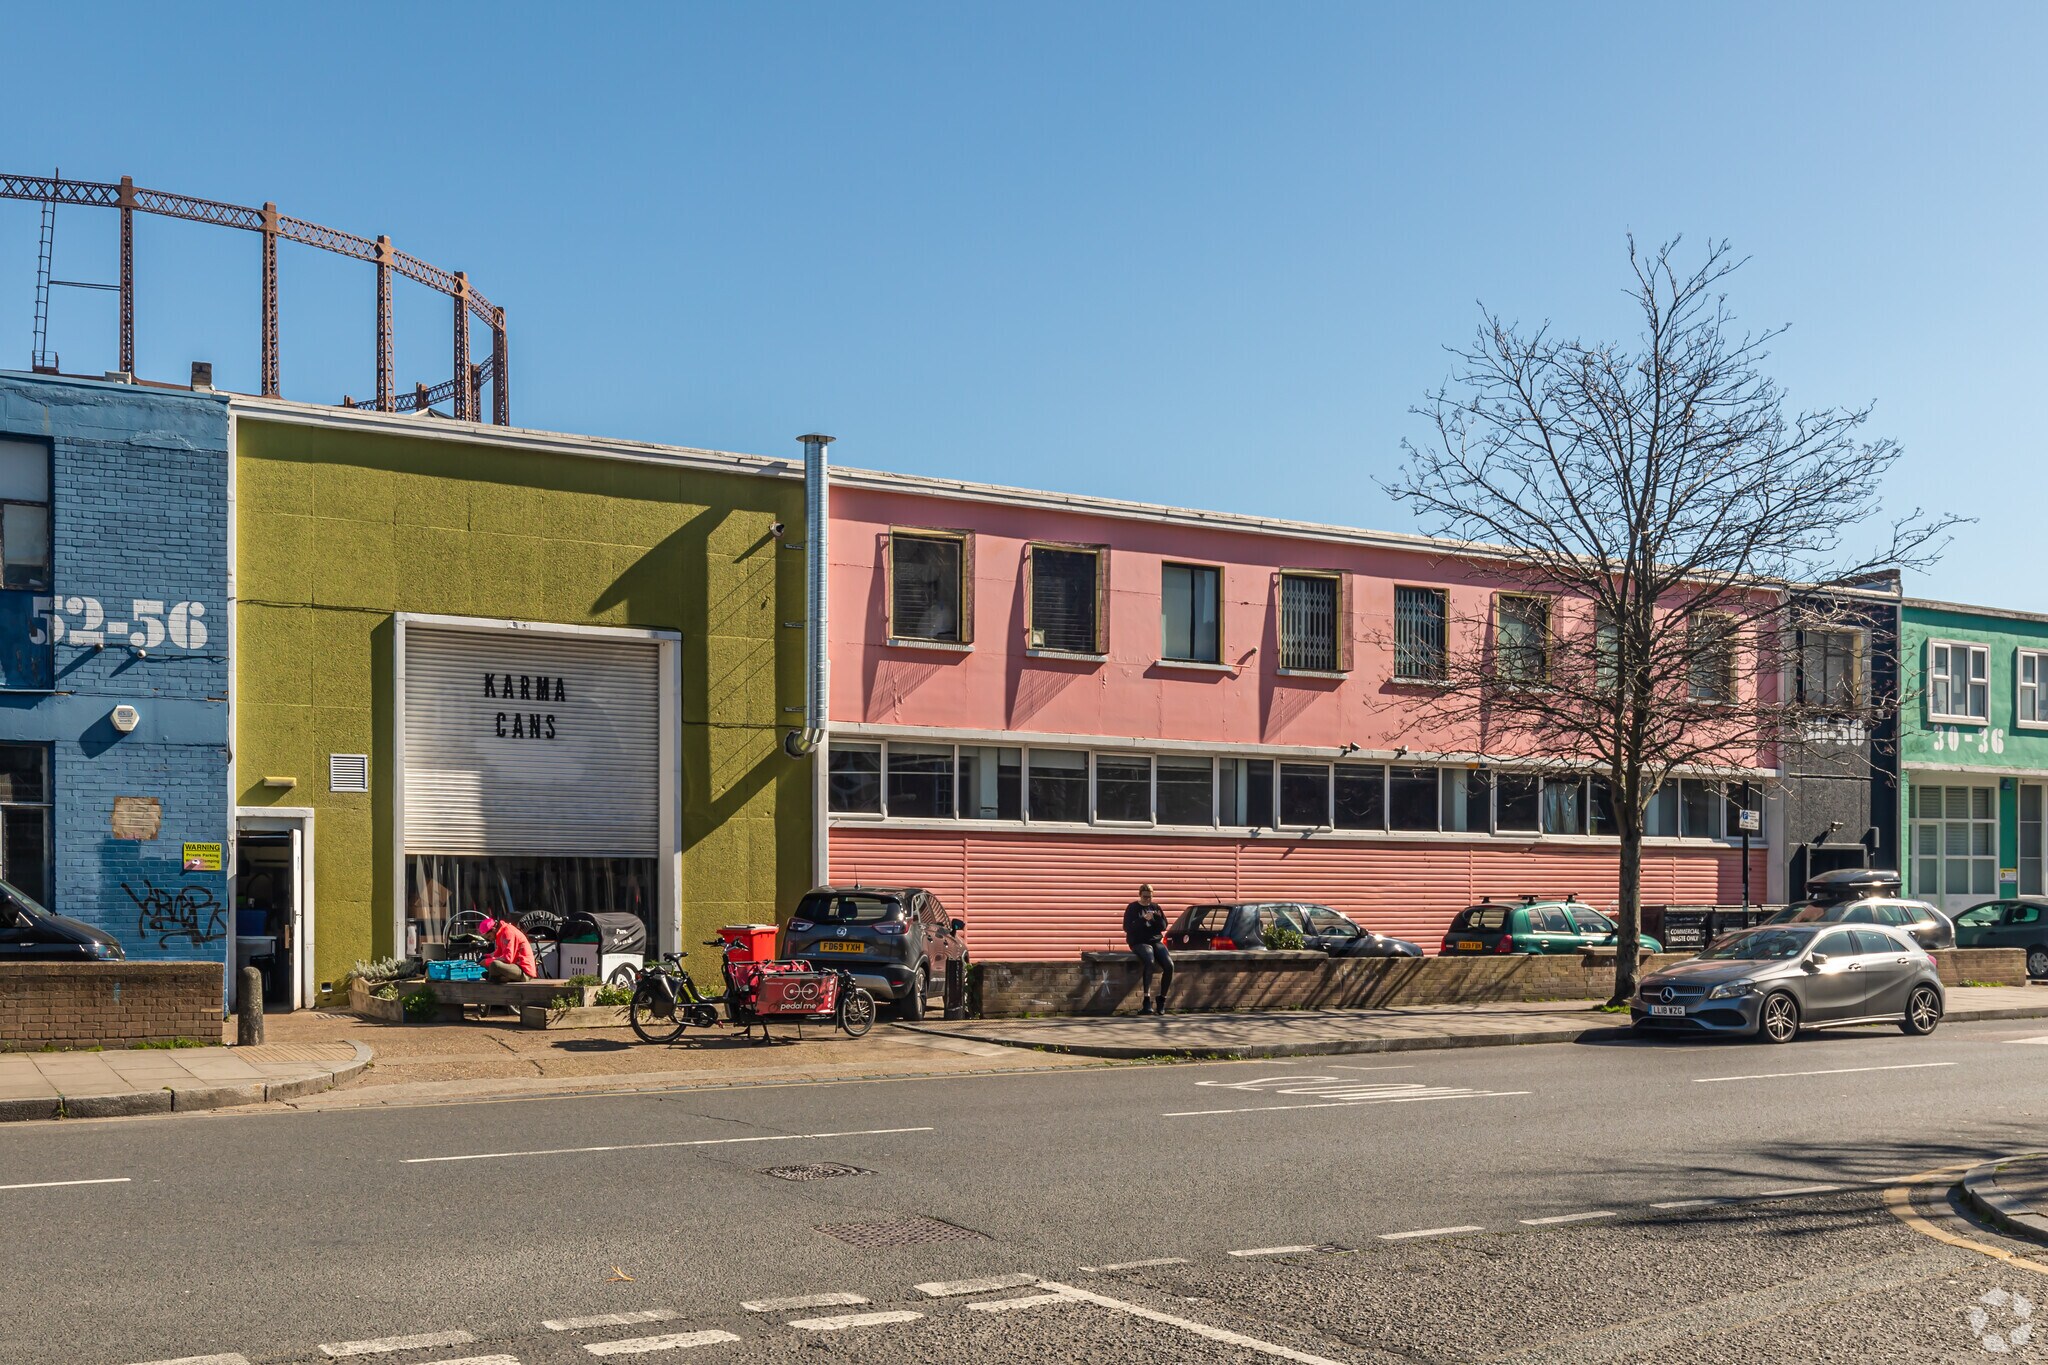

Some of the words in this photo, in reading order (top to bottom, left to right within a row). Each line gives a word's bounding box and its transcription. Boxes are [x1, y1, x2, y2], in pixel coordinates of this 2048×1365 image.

[29, 595, 208, 650] 52-56
[484, 673, 566, 702] KARMA
[496, 712, 556, 739] CANS
[185, 843, 220, 851] WARNING
[846, 943, 861, 951] YXH
[780, 1002, 802, 1011] pedal
